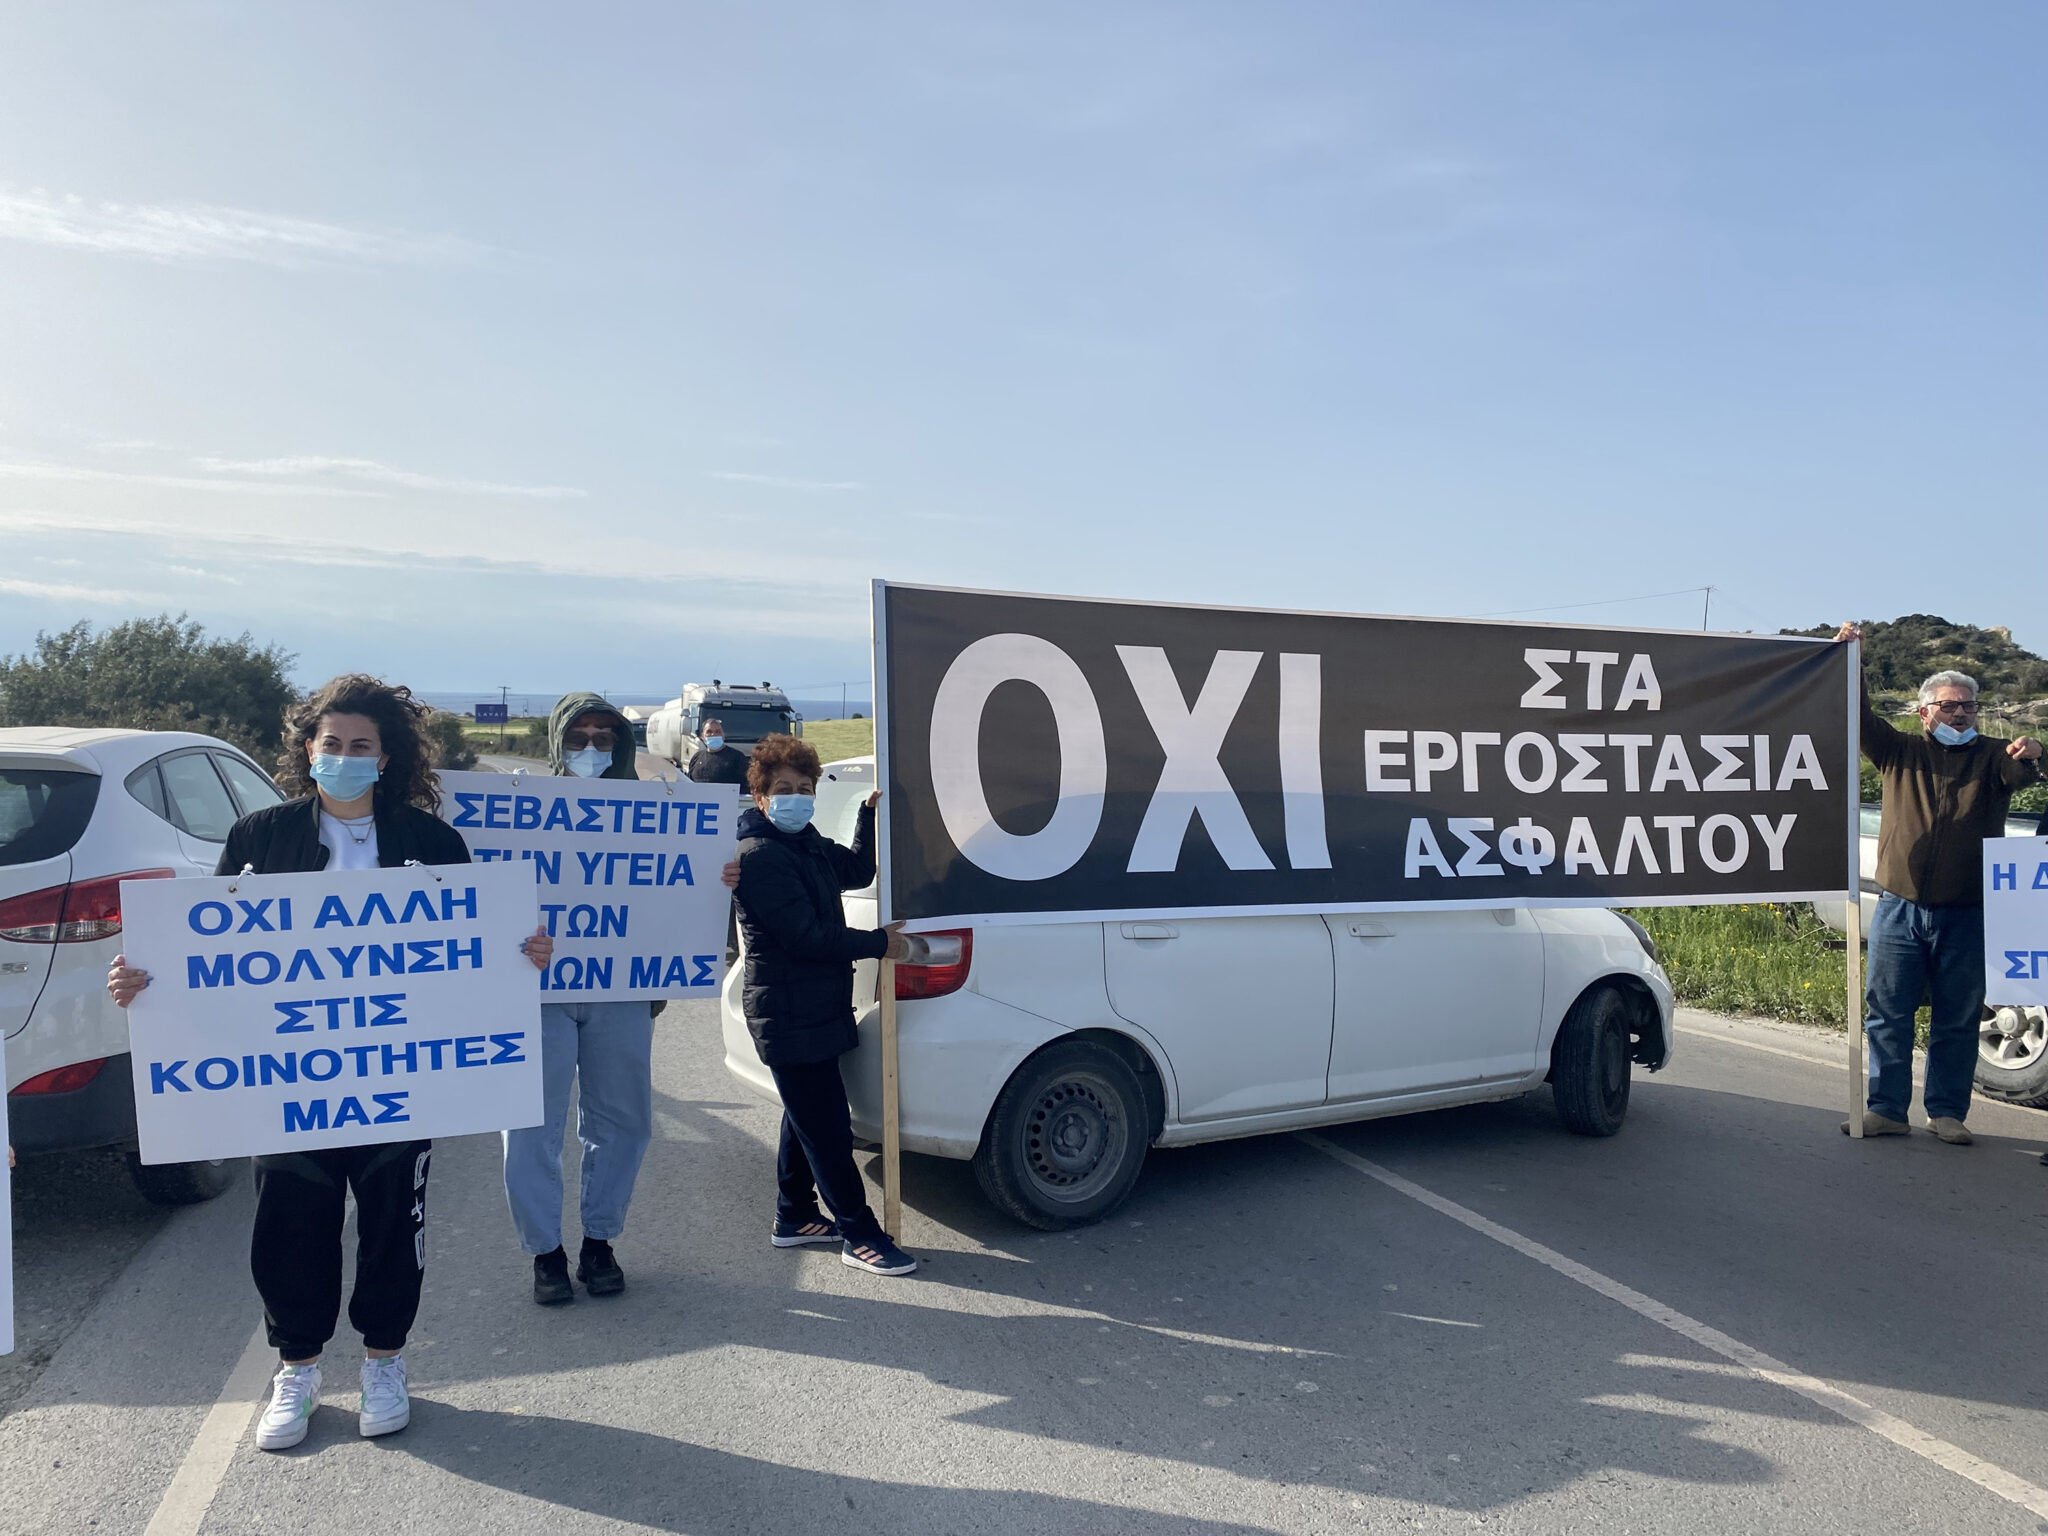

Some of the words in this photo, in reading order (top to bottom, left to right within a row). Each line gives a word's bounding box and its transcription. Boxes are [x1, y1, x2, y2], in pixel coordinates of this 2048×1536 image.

[1520, 648, 1662, 711] ΣΤΑ
[929, 632, 1332, 881] ΟΧΙ
[1364, 729, 1829, 794] ΕΡΓΟΣΤΑΣΙΑ
[452, 792, 720, 836] ΣΕΒΑΣΤΕΙΤΕ
[576, 851, 695, 887] ΥΓΕΙΑ
[1404, 813, 1798, 878] ΑΣΦΑΛΤΟΥ
[1993, 862, 2017, 890] Η
[187, 898, 293, 936] ΟΧΙ
[313, 886, 478, 929] ΑΛΛΗ
[540, 903, 629, 938] ΤΩΝ
[186, 936, 483, 990] ΜΟΛΥΝΣΗ
[628, 954, 718, 990] ΜΑΣ
[273, 992, 408, 1035] ΣΤΙΣ
[149, 1030, 526, 1096] ΚΟΙΝΟΤΗΤΕΣ
[282, 1090, 411, 1134] ΜΑΣ
